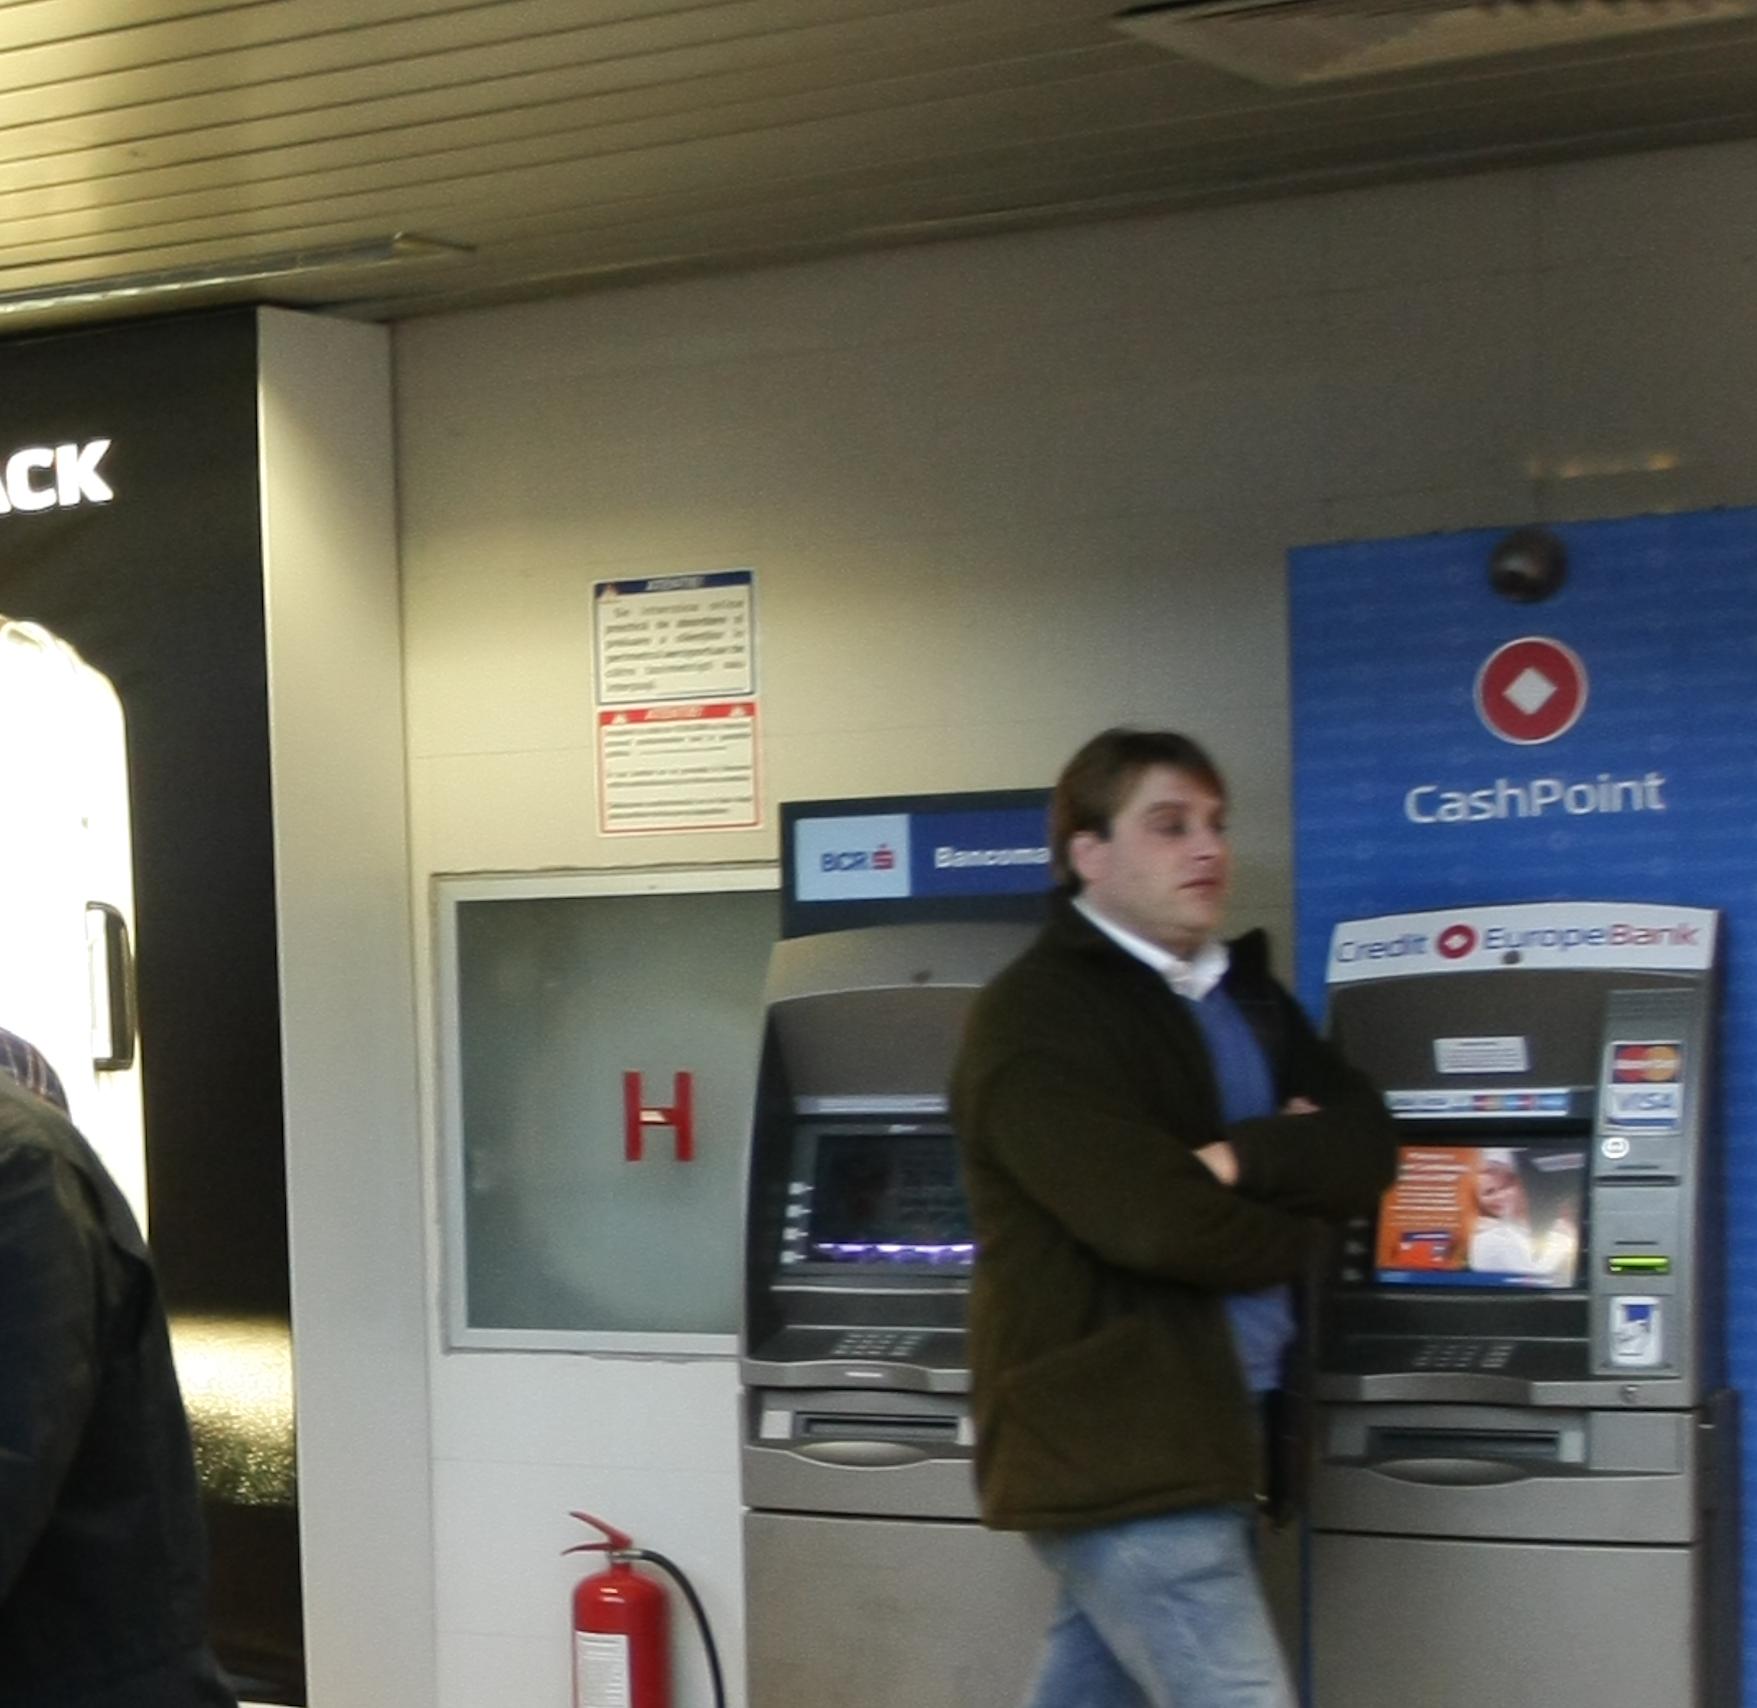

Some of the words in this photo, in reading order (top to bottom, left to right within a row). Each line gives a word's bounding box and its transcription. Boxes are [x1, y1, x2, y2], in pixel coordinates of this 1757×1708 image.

[1405, 772, 1666, 824] CashPoint
[820, 850, 869, 873] BCR
[935, 846, 1052, 868] Bancoma
[1335, 933, 1428, 963] Credit
[624, 1071, 693, 1161] H
